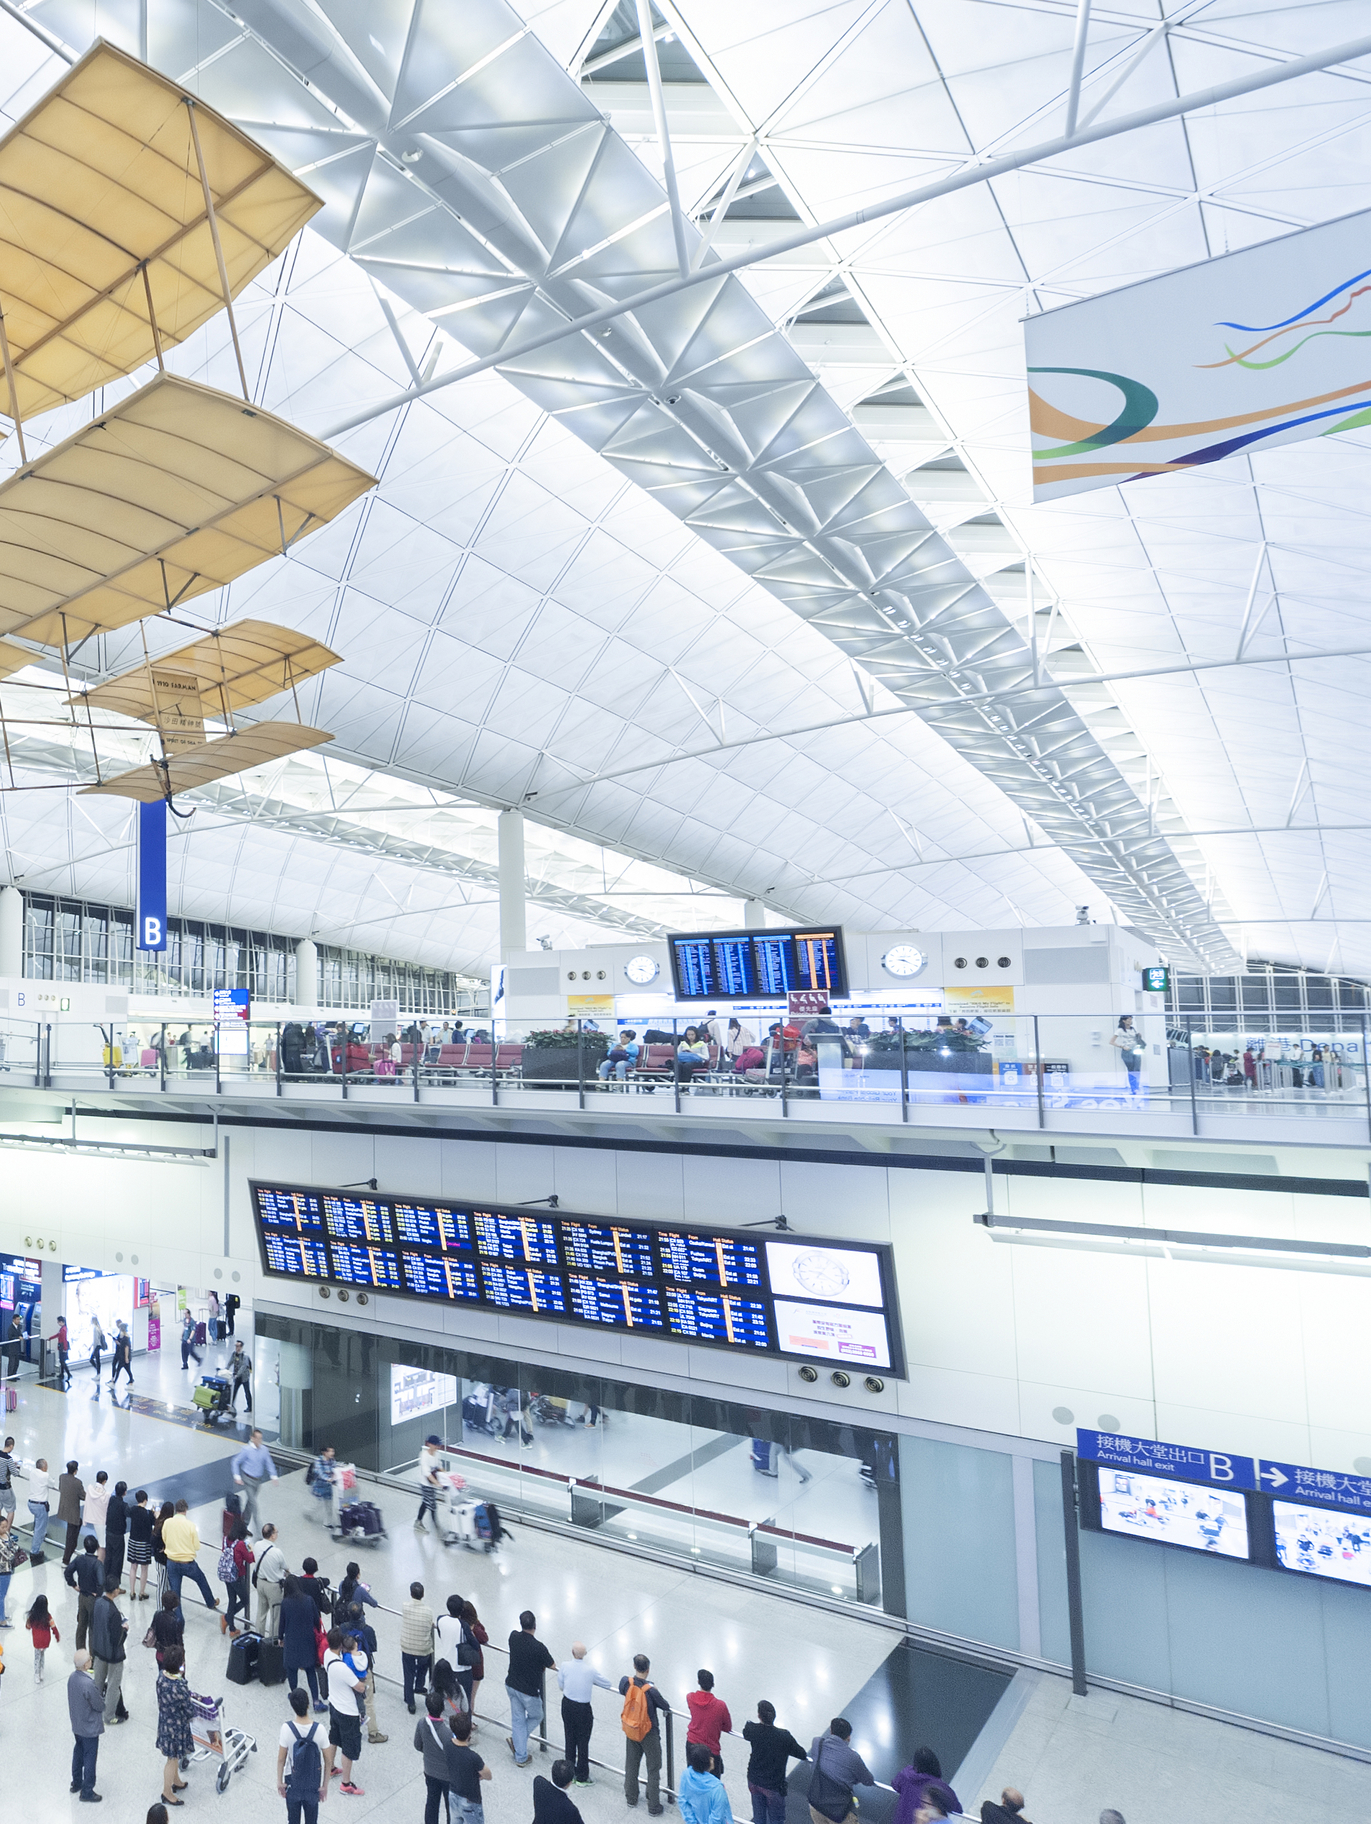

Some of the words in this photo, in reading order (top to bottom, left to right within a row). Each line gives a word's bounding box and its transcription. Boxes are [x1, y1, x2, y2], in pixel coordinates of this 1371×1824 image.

[145, 916, 162, 945] B
[17, 992, 26, 1007] B
[1096, 1433, 1204, 1465] 接機大堂出口
[1209, 1454, 1235, 1481] B
[1096, 1450, 1131, 1465] Arrival
[1133, 1455, 1153, 1468] hall
[1155, 1460, 1175, 1472] exit
[1295, 1486, 1335, 1501] Arrival
[1338, 1493, 1360, 1505] hall
